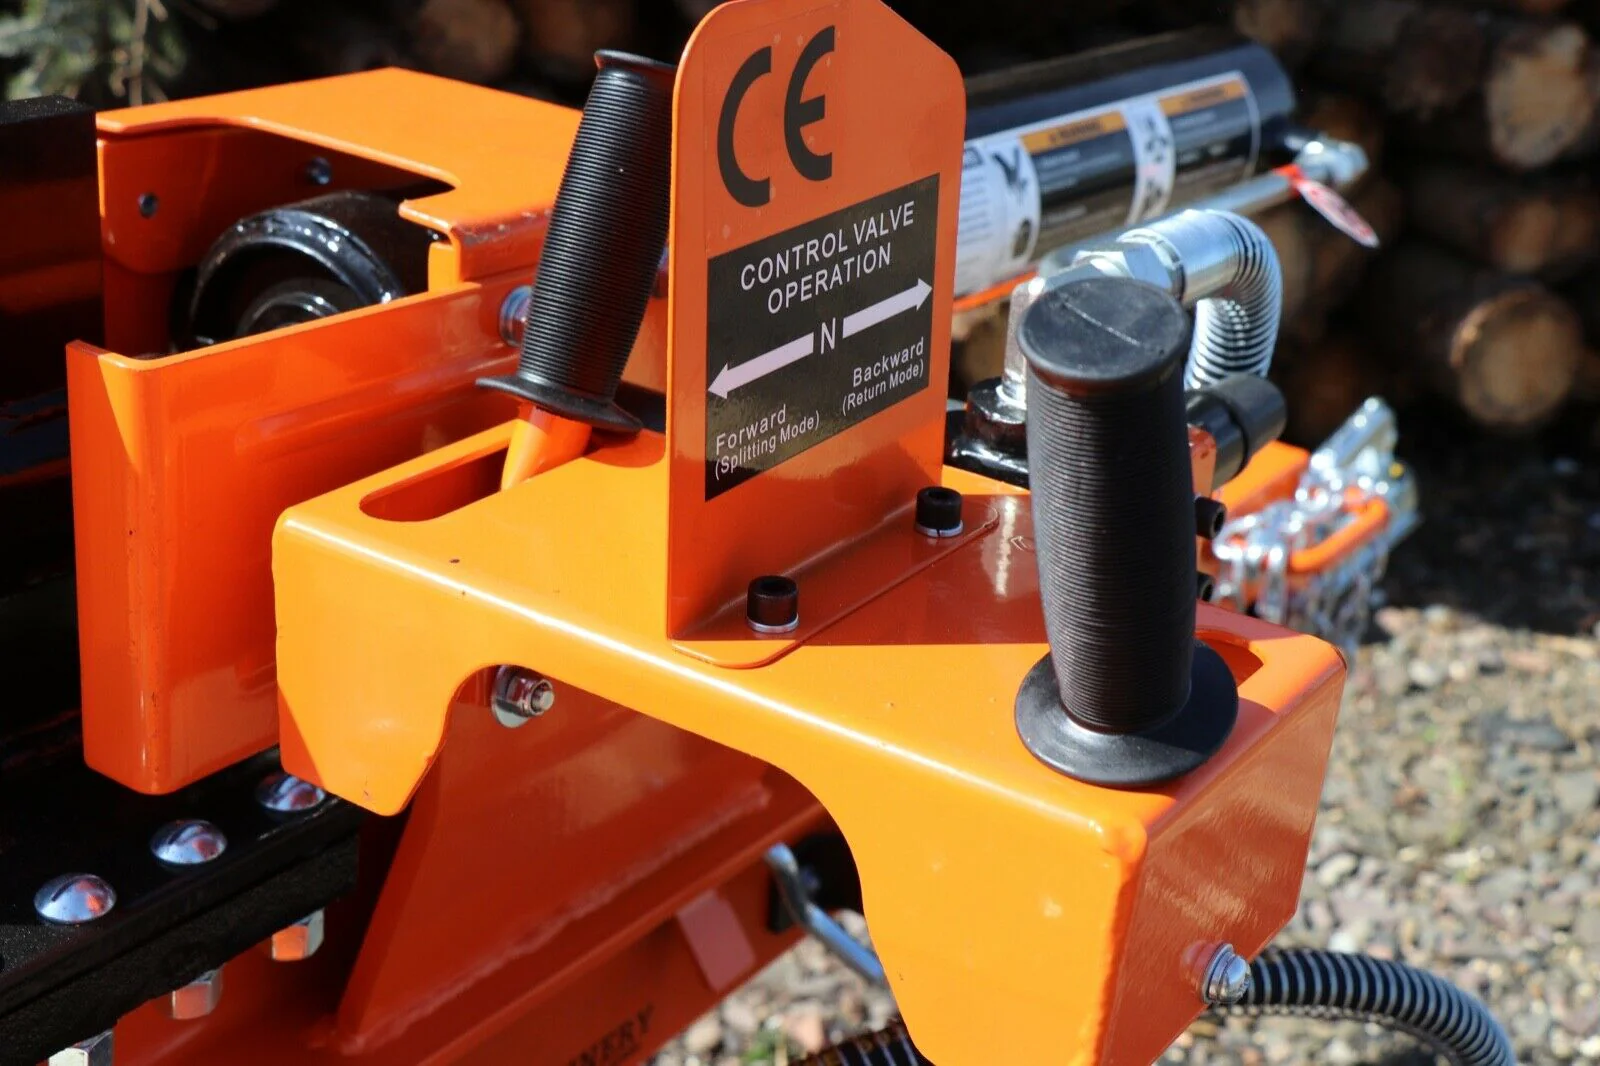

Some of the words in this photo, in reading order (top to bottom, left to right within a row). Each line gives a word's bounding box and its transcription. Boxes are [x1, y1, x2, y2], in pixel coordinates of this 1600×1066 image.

[717, 25, 836, 208] CE
[740, 229, 848, 292] CONTROL
[853, 200, 915, 246] VALVE
[767, 242, 891, 315] OPERATION
[820, 317, 837, 355] N
[852, 336, 925, 388] Backward
[842, 379, 887, 416] (Return
[889, 359, 924, 389] Mode)
[714, 432, 777, 481] (Splitting
[779, 410, 820, 443] Mode)
[715, 404, 787, 456] Forward
